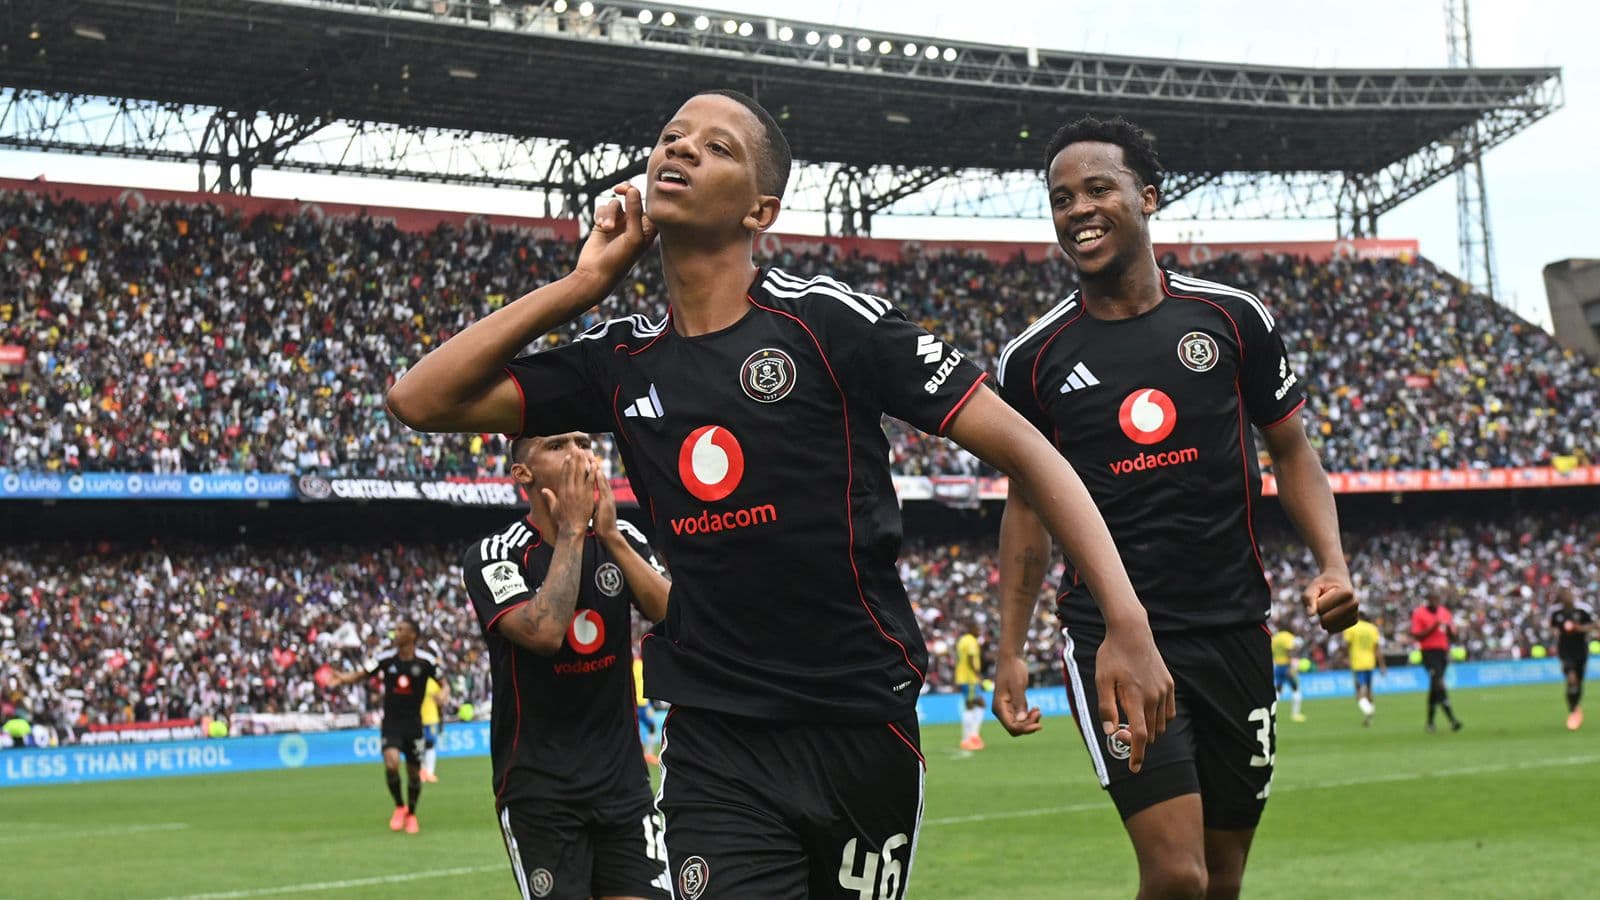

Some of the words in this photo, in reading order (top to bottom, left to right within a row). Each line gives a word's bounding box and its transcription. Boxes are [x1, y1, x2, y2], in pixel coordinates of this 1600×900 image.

[924, 348, 965, 394] SUZU
[1109, 447, 1199, 475] vodacom
[671, 504, 777, 536] vodacom
[553, 655, 617, 675] vodacom
[6, 754, 68, 779] LESS
[73, 750, 137, 774] THAN
[145, 746, 231, 770] PETROL
[838, 833, 908, 900] 46
